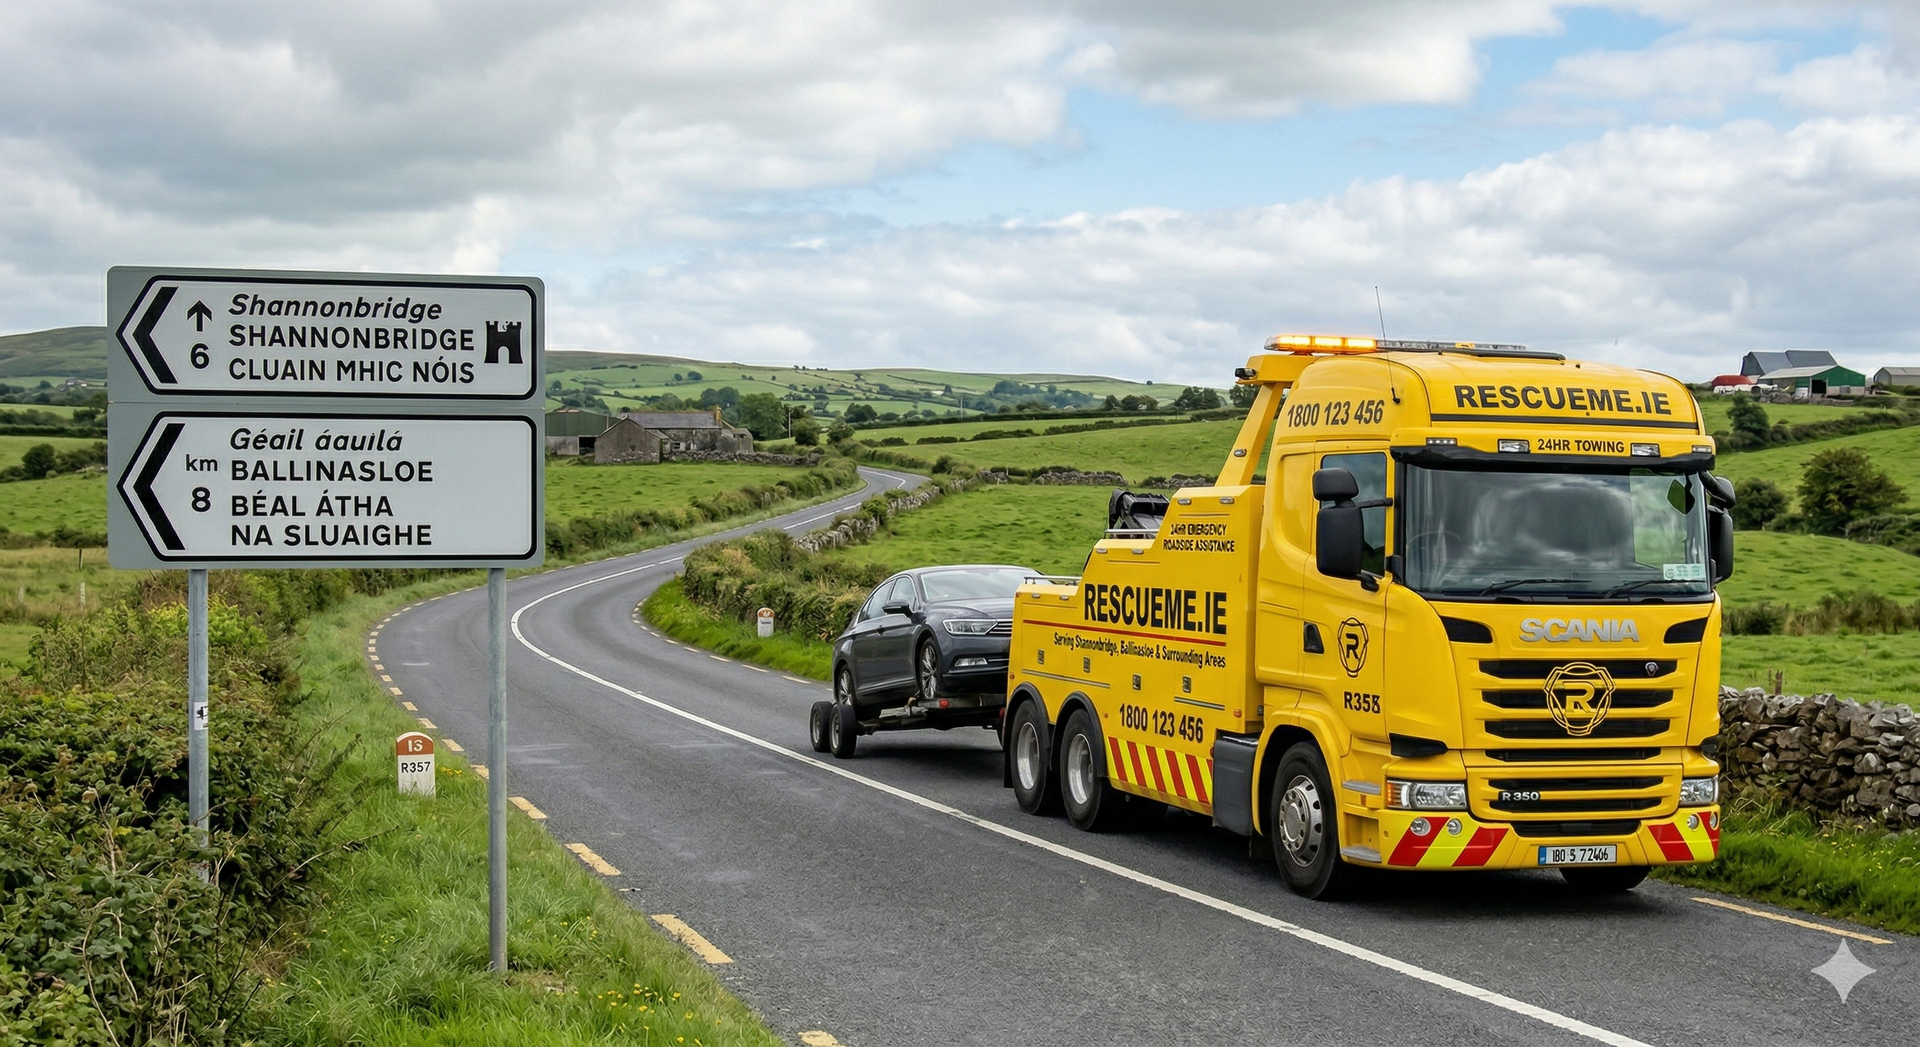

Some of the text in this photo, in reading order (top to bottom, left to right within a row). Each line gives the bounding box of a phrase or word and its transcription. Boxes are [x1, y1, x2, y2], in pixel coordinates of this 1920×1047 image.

[228, 294, 442, 323] Shannonbridge
[229, 324, 475, 350] SHANNONBRIDGE
[190, 343, 210, 369] 6
[229, 356, 475, 383] CLUAIN MHIC NÓIS
[1454, 385, 1671, 415] RESCUEME.IE
[1287, 399, 1385, 427] 1800 123 456
[230, 428, 304, 450] Géail
[1538, 438, 1625, 453] 24HR TOWING
[186, 454, 218, 471] km
[231, 460, 433, 482] BALLINASLOE
[191, 487, 211, 512] 8
[231, 489, 394, 516] BÉAL ÁTHA
[231, 525, 432, 546] NA SLUAIGHE
[1084, 583, 1227, 635] RESCUEME.IE
[1519, 618, 1640, 642] SCANIA
[1204, 651, 1226, 668] Areas
[1119, 703, 1204, 744] 1800 123 456
[401, 761, 431, 773] R357
[1513, 791, 1540, 801] 350
